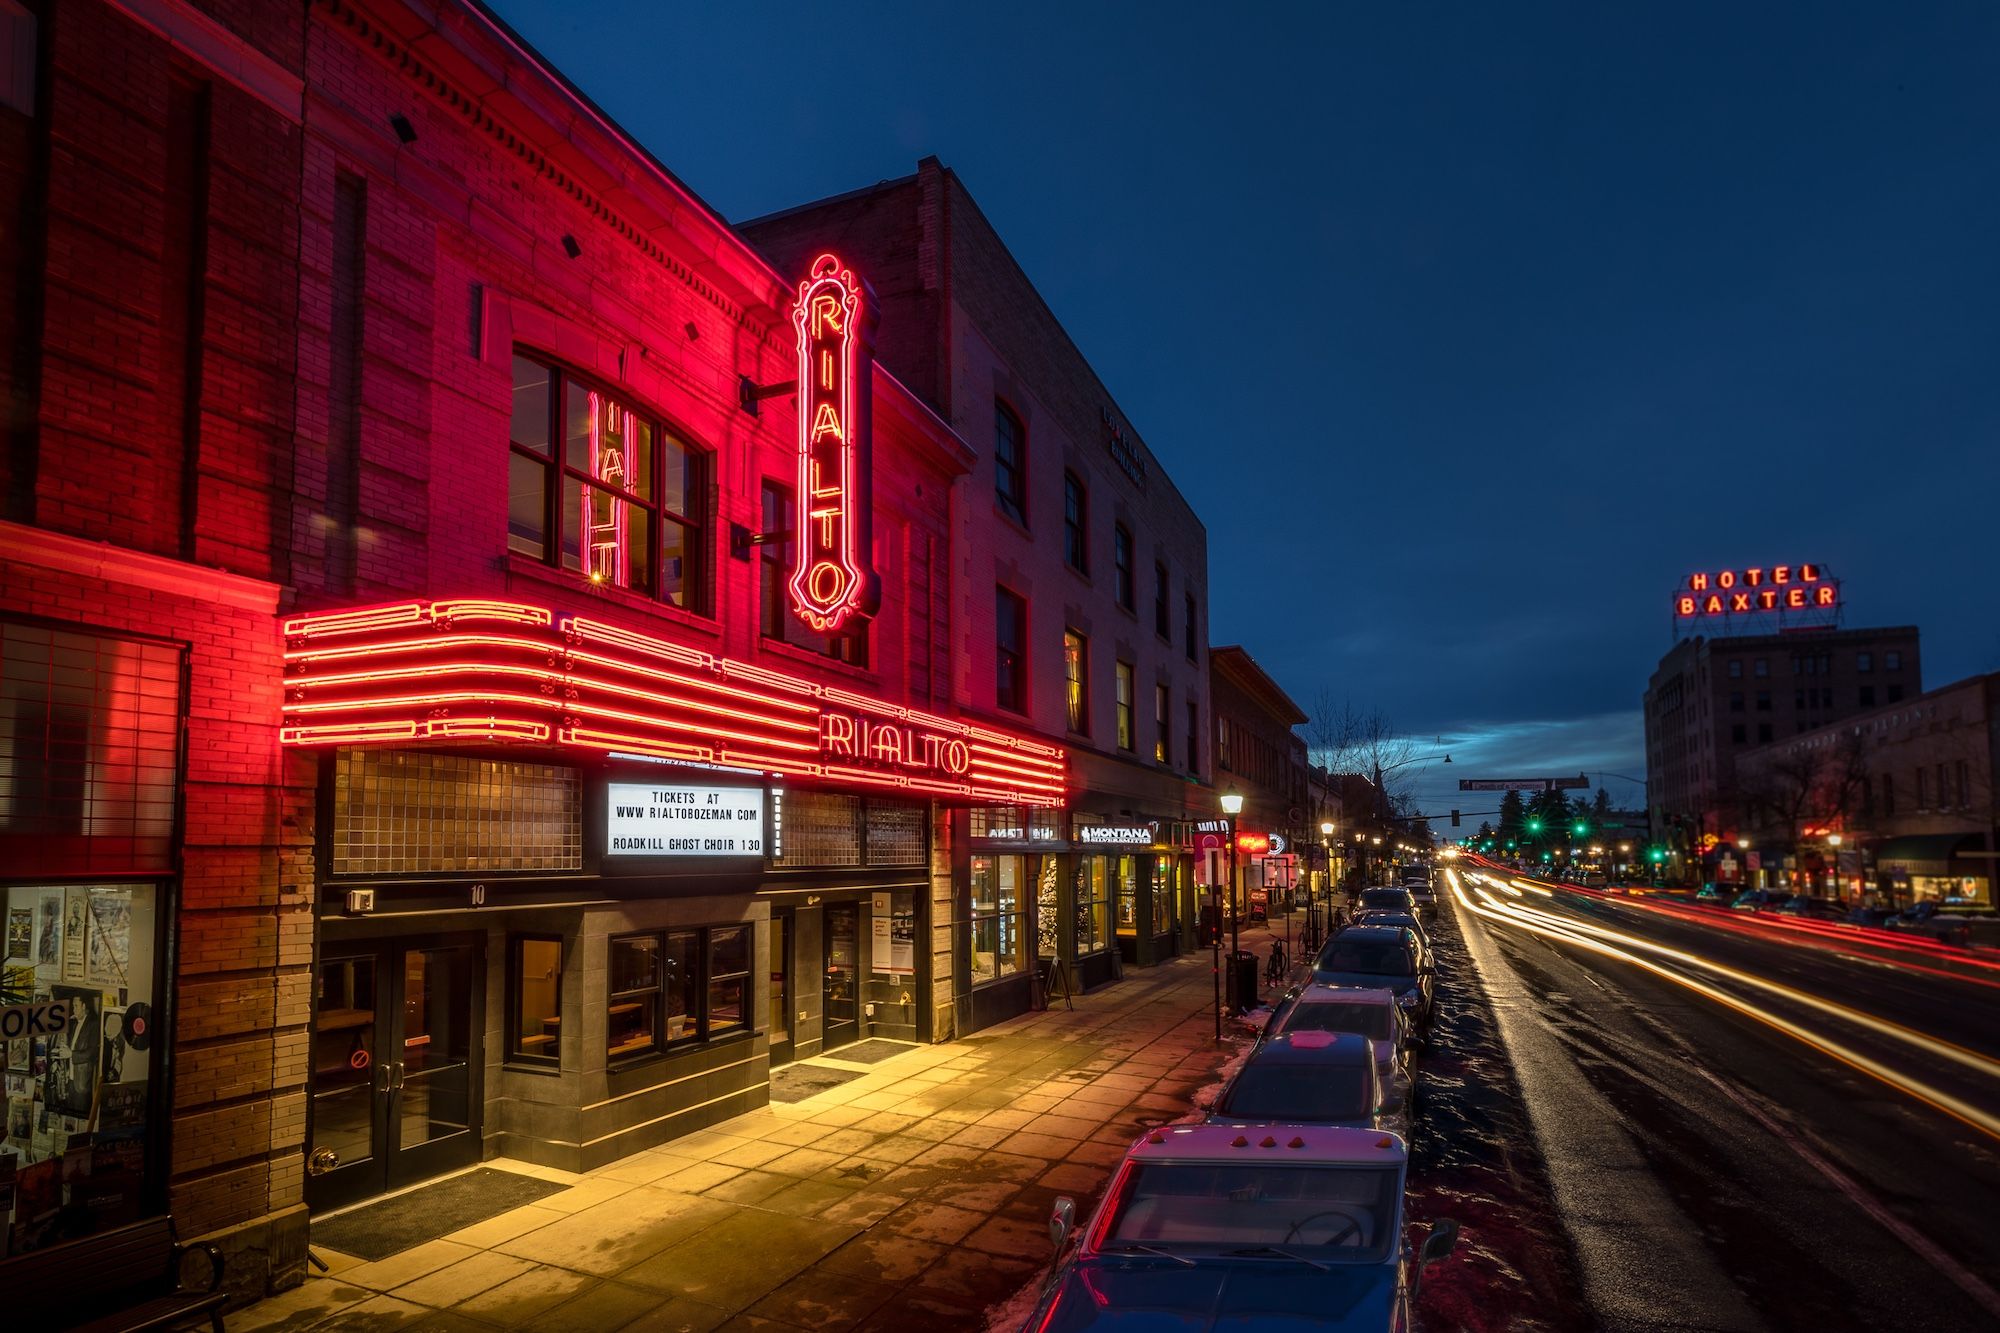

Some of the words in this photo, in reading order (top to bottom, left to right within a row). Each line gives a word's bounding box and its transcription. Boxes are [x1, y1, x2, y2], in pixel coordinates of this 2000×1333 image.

[809, 296, 844, 602] RIALTO
[1693, 565, 1817, 590] HOTEL
[1681, 587, 1833, 614] BAXTER
[819, 714, 969, 773] RIALTO
[653, 791, 695, 804] TICKETS
[707, 793, 719, 804] AT
[616, 806, 644, 818] WWW
[649, 807, 732, 820] RIALTOBOZEMAN
[737, 809, 757, 821] COM
[1090, 828, 1151, 838] MONTANA
[613, 838, 664, 850] ROADKILL
[669, 838, 700, 850] GHOST
[704, 839, 734, 851] CHOIR
[471, 885, 485, 905] 10
